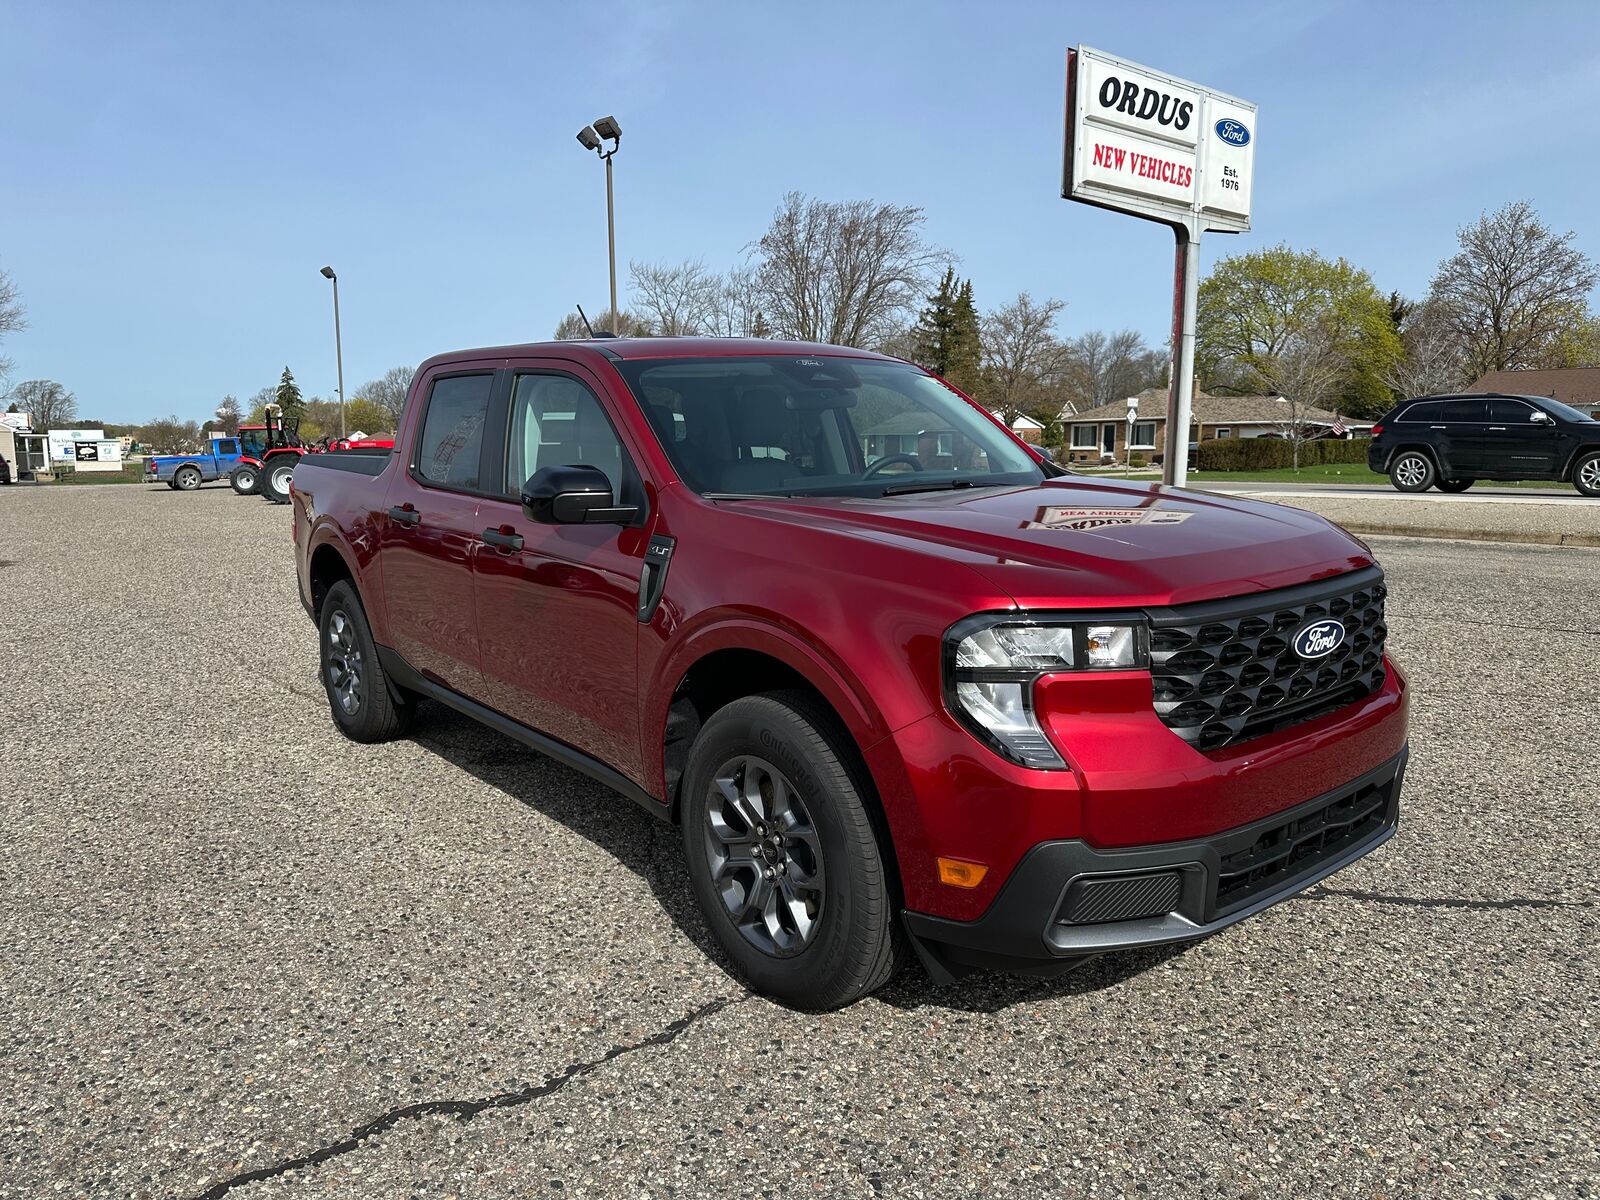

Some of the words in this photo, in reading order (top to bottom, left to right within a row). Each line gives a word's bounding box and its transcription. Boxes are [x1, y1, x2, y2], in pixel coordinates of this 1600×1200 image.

[1099, 76, 1194, 131] ORDUS
[1222, 121, 1245, 142] Ford
[1092, 143, 1127, 172] NEW
[1130, 152, 1193, 188] VEHICLES
[1223, 165, 1239, 178] Est.
[1220, 178, 1239, 191] 1976
[1305, 625, 1338, 654] Ford
